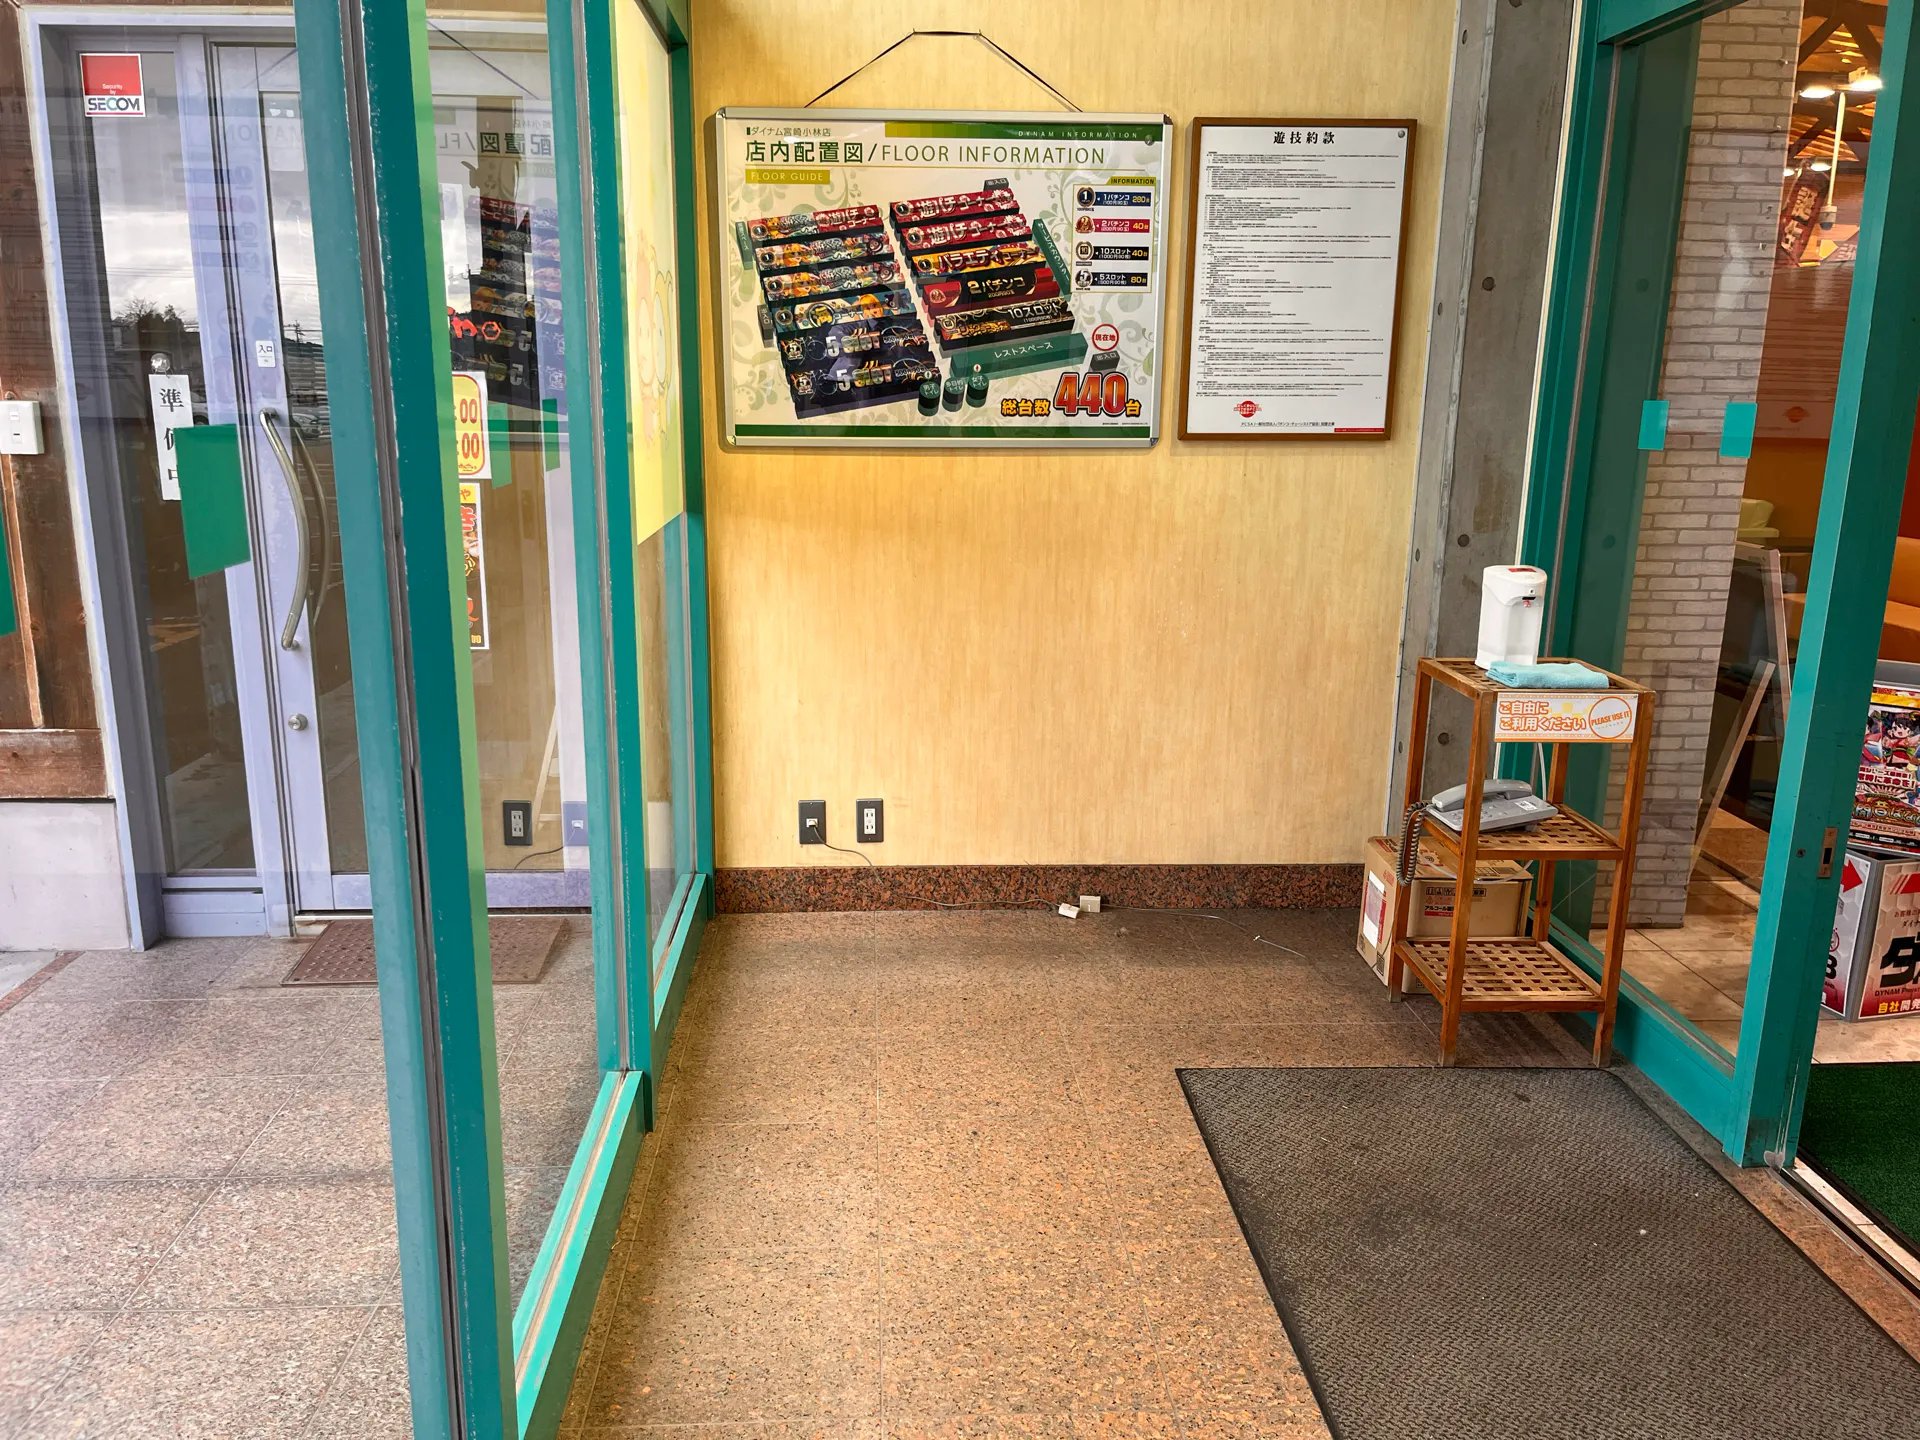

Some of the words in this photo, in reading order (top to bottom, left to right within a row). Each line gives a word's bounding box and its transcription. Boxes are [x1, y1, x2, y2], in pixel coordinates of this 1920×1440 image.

[88, 97, 140, 111] SECOM
[1273, 131, 1335, 144] 遊技約款
[959, 145, 1105, 164] INFORMATION
[751, 171, 786, 181] FLOOR
[790, 172, 823, 181] GUIDE
[258, 344, 273, 354] 入口
[994, 342, 1054, 359] レストスペース
[1499, 700, 1549, 715] ご自由に
[1499, 716, 1587, 731] ご利用ください
[1590, 715, 1611, 726] PLEASE
[1612, 713, 1623, 721] USE
[1623, 710, 1631, 718] IT
[1894, 908, 1920, 918] お客様の
[1875, 988, 1900, 996] DYNAM
